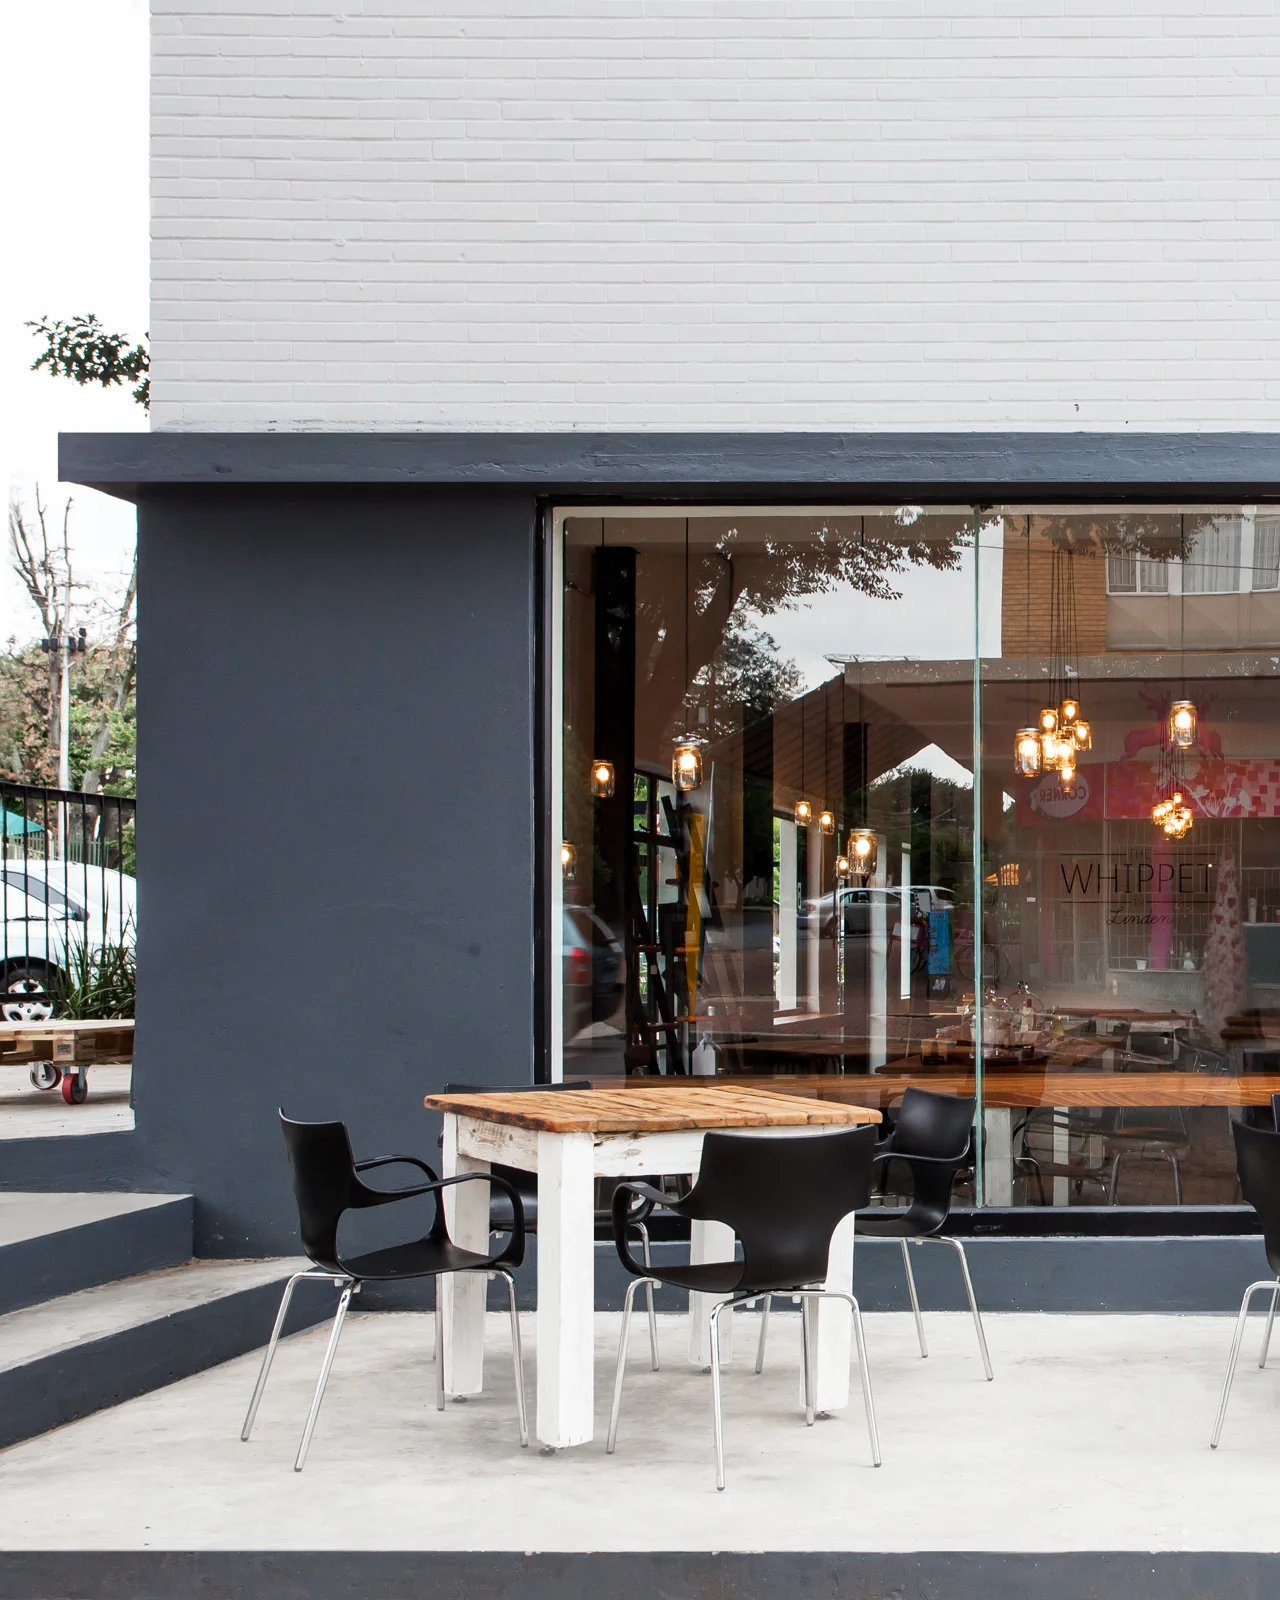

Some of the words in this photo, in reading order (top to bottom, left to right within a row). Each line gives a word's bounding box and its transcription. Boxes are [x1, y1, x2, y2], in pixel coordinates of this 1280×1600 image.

[1129, 849, 1150, 859] THE
[1060, 863, 1217, 894] WHIPPET
[1106, 906, 1173, 925] Linden
